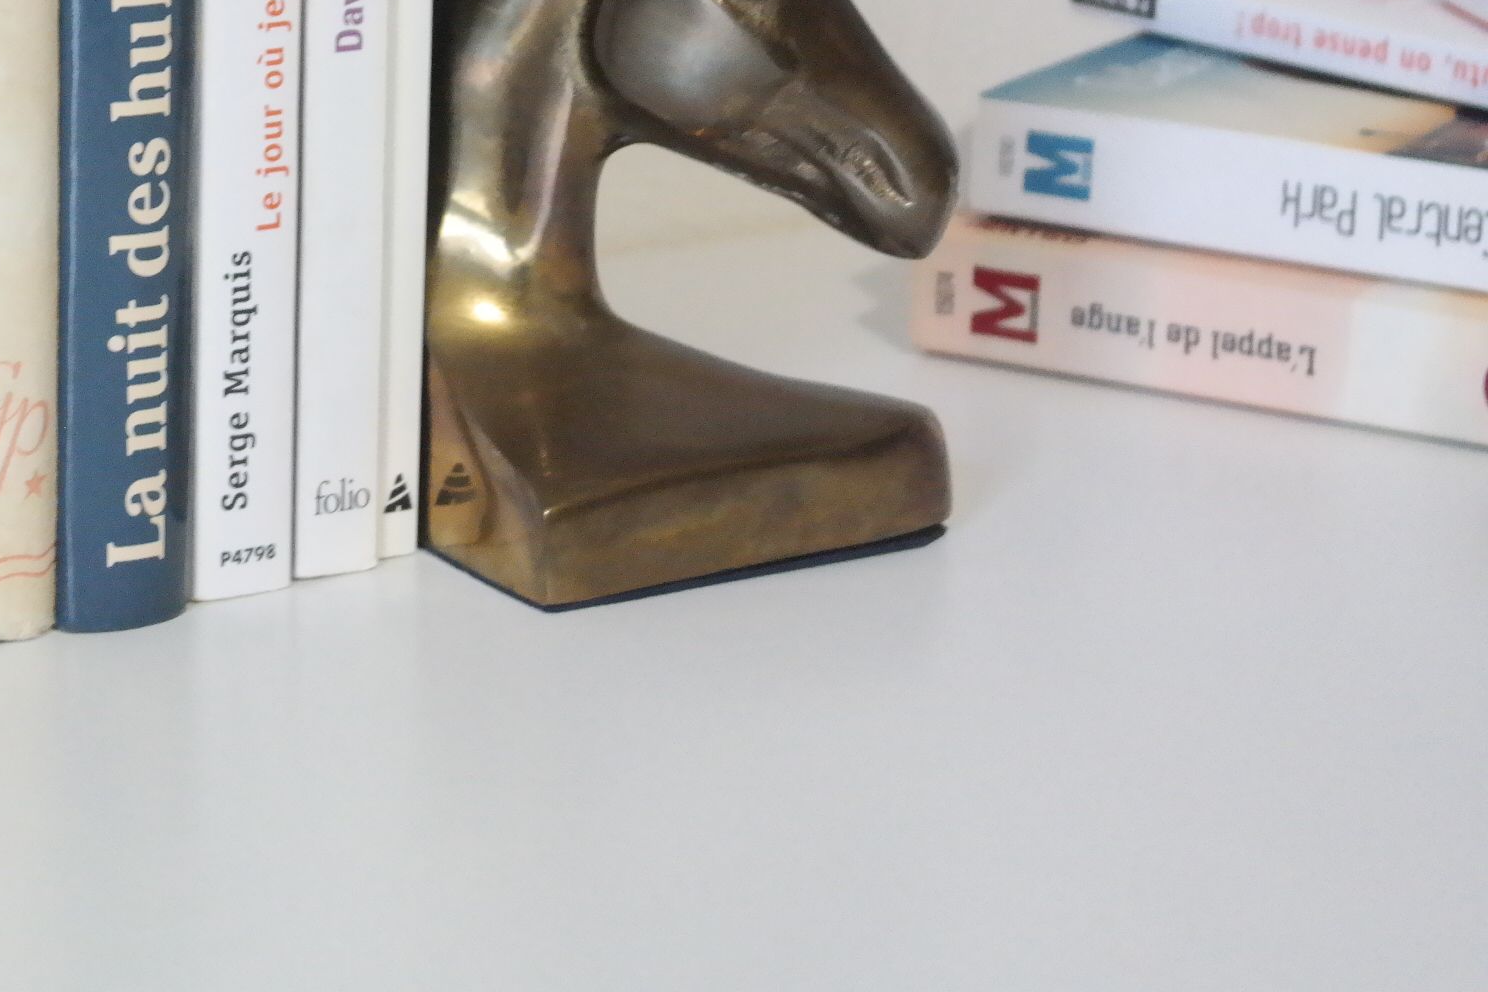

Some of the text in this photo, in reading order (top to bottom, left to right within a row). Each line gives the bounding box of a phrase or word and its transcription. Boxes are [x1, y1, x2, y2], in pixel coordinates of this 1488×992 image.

[256, 45, 286, 91] où
[1313, 28, 1390, 66] pense
[1398, 48, 1433, 75] on
[255, 104, 291, 178] jour
[1023, 129, 1095, 202] M
[108, 135, 173, 280] des
[256, 190, 282, 233] Le
[1280, 179, 1359, 238] Park
[969, 265, 1041, 345] M
[1069, 302, 1318, 377] L'appel de l'ange
[105, 294, 171, 448] nuit
[221, 249, 260, 512] Serge Marquis
[105, 467, 169, 569] La
[313, 477, 372, 516] folio
[220, 543, 277, 567] P4798
